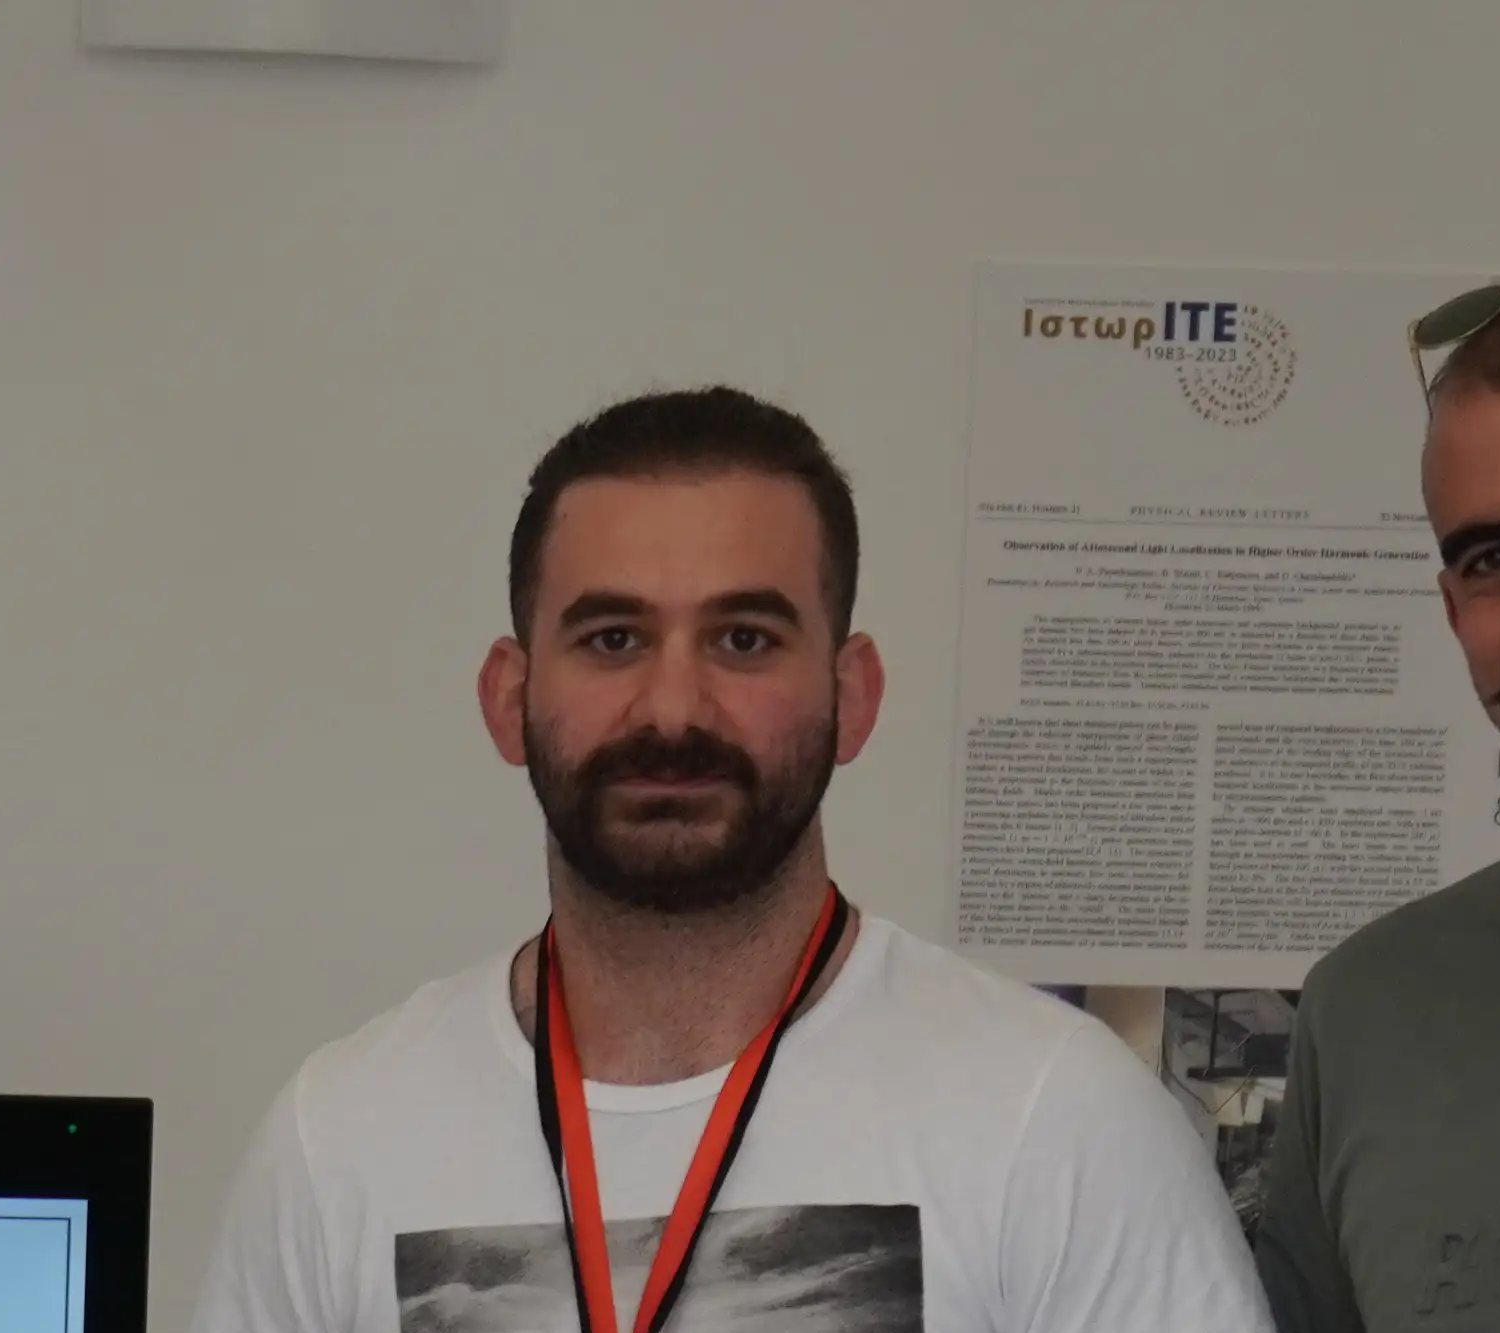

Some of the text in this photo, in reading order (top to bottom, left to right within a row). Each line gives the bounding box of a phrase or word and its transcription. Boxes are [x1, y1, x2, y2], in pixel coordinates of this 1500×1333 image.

[1145, 346, 1237, 362] 1983-2023
[1003, 540, 1066, 552] Observation
[1068, 541, 1080, 553] of
[1141, 544, 1168, 558] Light
[1287, 548, 1317, 558] Order
